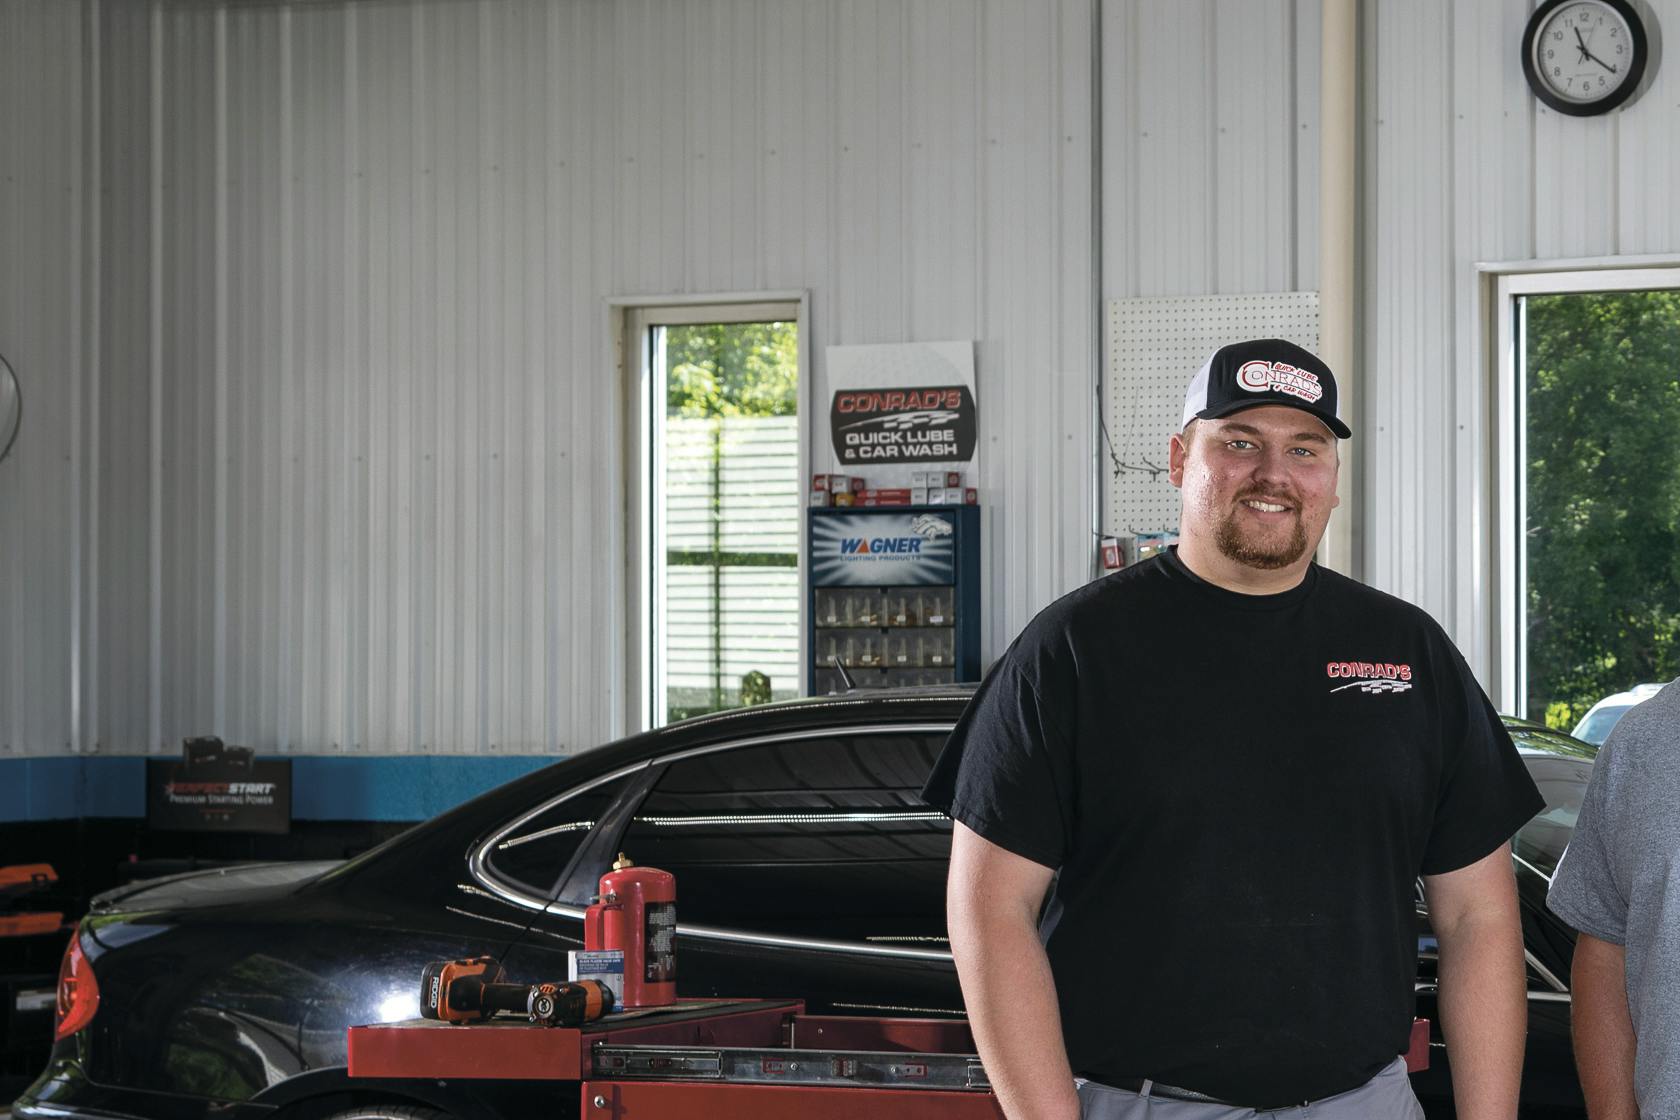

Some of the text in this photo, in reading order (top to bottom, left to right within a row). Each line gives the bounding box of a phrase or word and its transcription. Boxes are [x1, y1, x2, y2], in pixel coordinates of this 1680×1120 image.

[1579, 12, 1590, 22] 12
[1564, 18, 1573, 28] 11
[1553, 30, 1563, 41] 10
[1610, 27, 1617, 37] 2
[1547, 50, 1554, 59] 9
[1616, 45, 1623, 55] 3
[1554, 67, 1561, 77] 8
[1566, 77, 1573, 87] 7
[1583, 81, 1590, 91] 6
[1598, 76, 1605, 86] 5
[1297, 368, 1317, 381] LUBE
[837, 390, 961, 413] CONRAD'S
[846, 430, 955, 445] QUICK LUBE
[845, 444, 957, 459] & CAR WASH
[841, 537, 922, 554] WAGNER
[1326, 661, 1412, 681] CONRAD'S
[431, 976, 440, 1009] RIDGID
